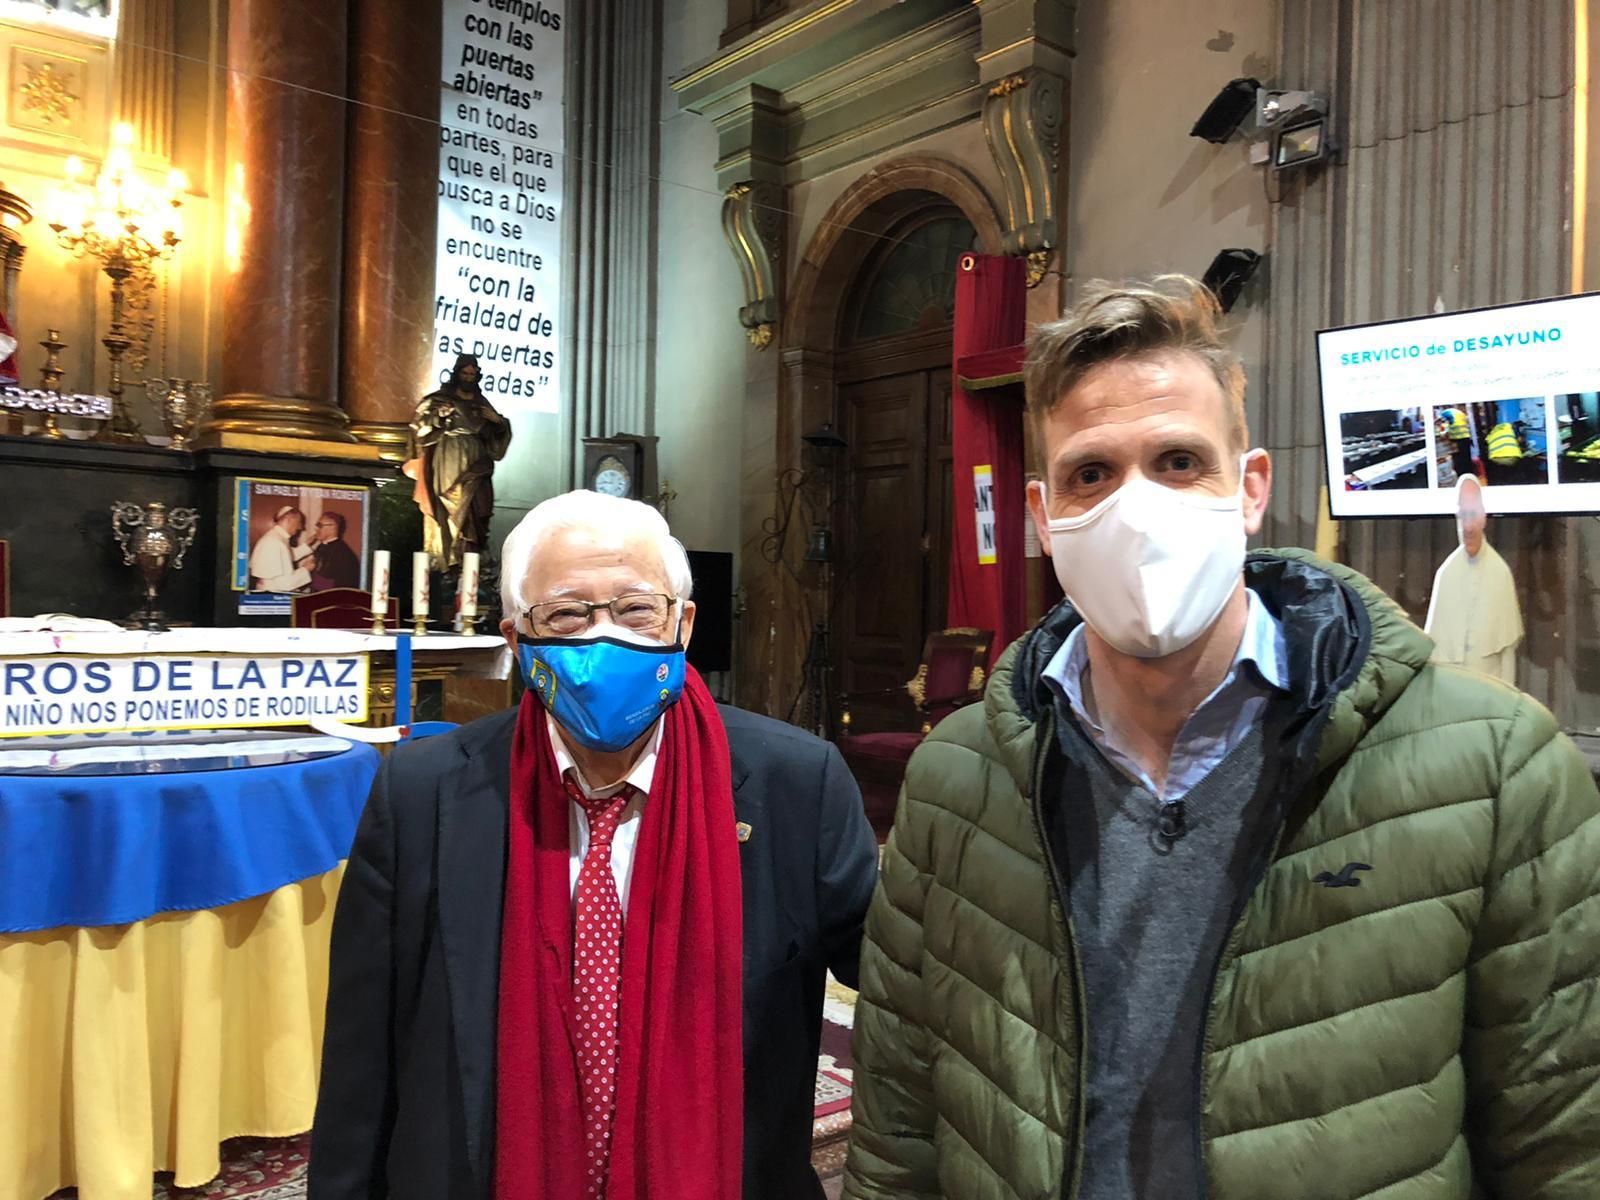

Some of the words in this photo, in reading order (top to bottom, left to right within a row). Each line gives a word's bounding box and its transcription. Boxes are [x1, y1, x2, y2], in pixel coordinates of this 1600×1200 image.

[465, 13, 501, 40] con
[507, 22, 534, 50] las
[461, 44, 535, 80] puertas
[457, 103, 479, 124] en
[486, 108, 538, 139] todas
[440, 126, 506, 161] partes,
[513, 145, 553, 169] para
[448, 155, 484, 178] que
[490, 162, 506, 183] el
[513, 172, 547, 193] que
[500, 194, 509, 211] a
[516, 194, 556, 222] Dios
[471, 215, 495, 234] no
[501, 221, 523, 240] se
[446, 238, 543, 271] encuentre
[517, 277, 535, 302] la
[435, 296, 522, 332] frialdad
[528, 313, 553, 337] de
[473, 340, 554, 369] puertas
[1340, 345, 1421, 367] SERVICIO
[1426, 344, 1446, 357] de
[1453, 327, 1562, 353] DESAYUNO
[5, 661, 112, 696] ROS
[132, 660, 193, 692] DE
[212, 660, 267, 690] LA
[281, 659, 358, 689] PAZ
[6, 698, 63, 727] NIÑO
[70, 701, 117, 724] NOS
[125, 697, 228, 723] PONEMOS
[235, 697, 260, 718] DE
[267, 694, 359, 717] RODILLAS
